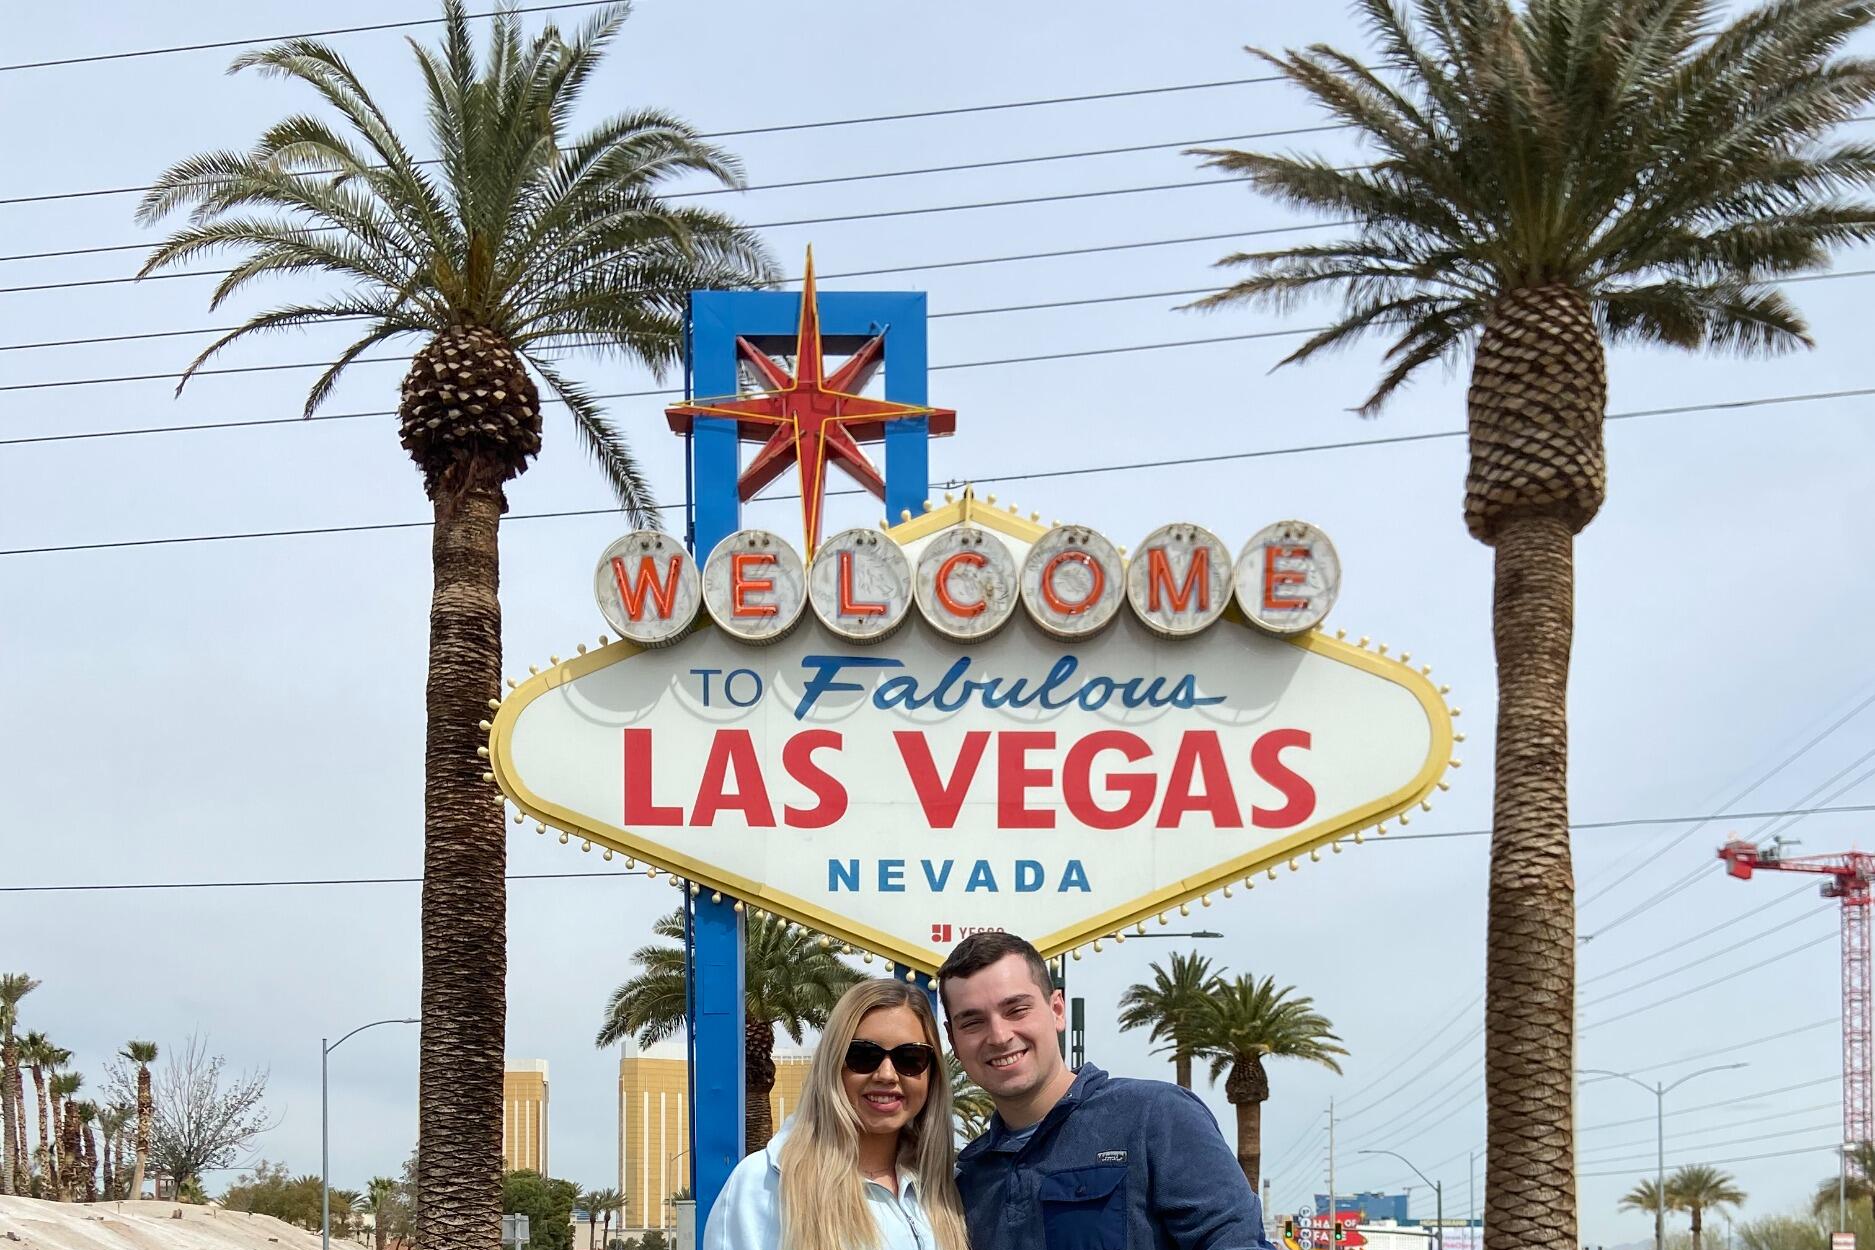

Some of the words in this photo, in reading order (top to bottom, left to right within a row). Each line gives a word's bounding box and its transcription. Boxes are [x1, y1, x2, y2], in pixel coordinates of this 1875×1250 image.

[611, 545, 1310, 622] WELCOME
[689, 668, 763, 708] TO
[793, 655, 1226, 720] Fabulous
[623, 728, 849, 829] LAS
[893, 729, 1317, 830] VEGAS
[827, 858, 1091, 893] NEVADA
[1313, 1219, 1342, 1231] HA
[1313, 1231, 1347, 1242] FAE
